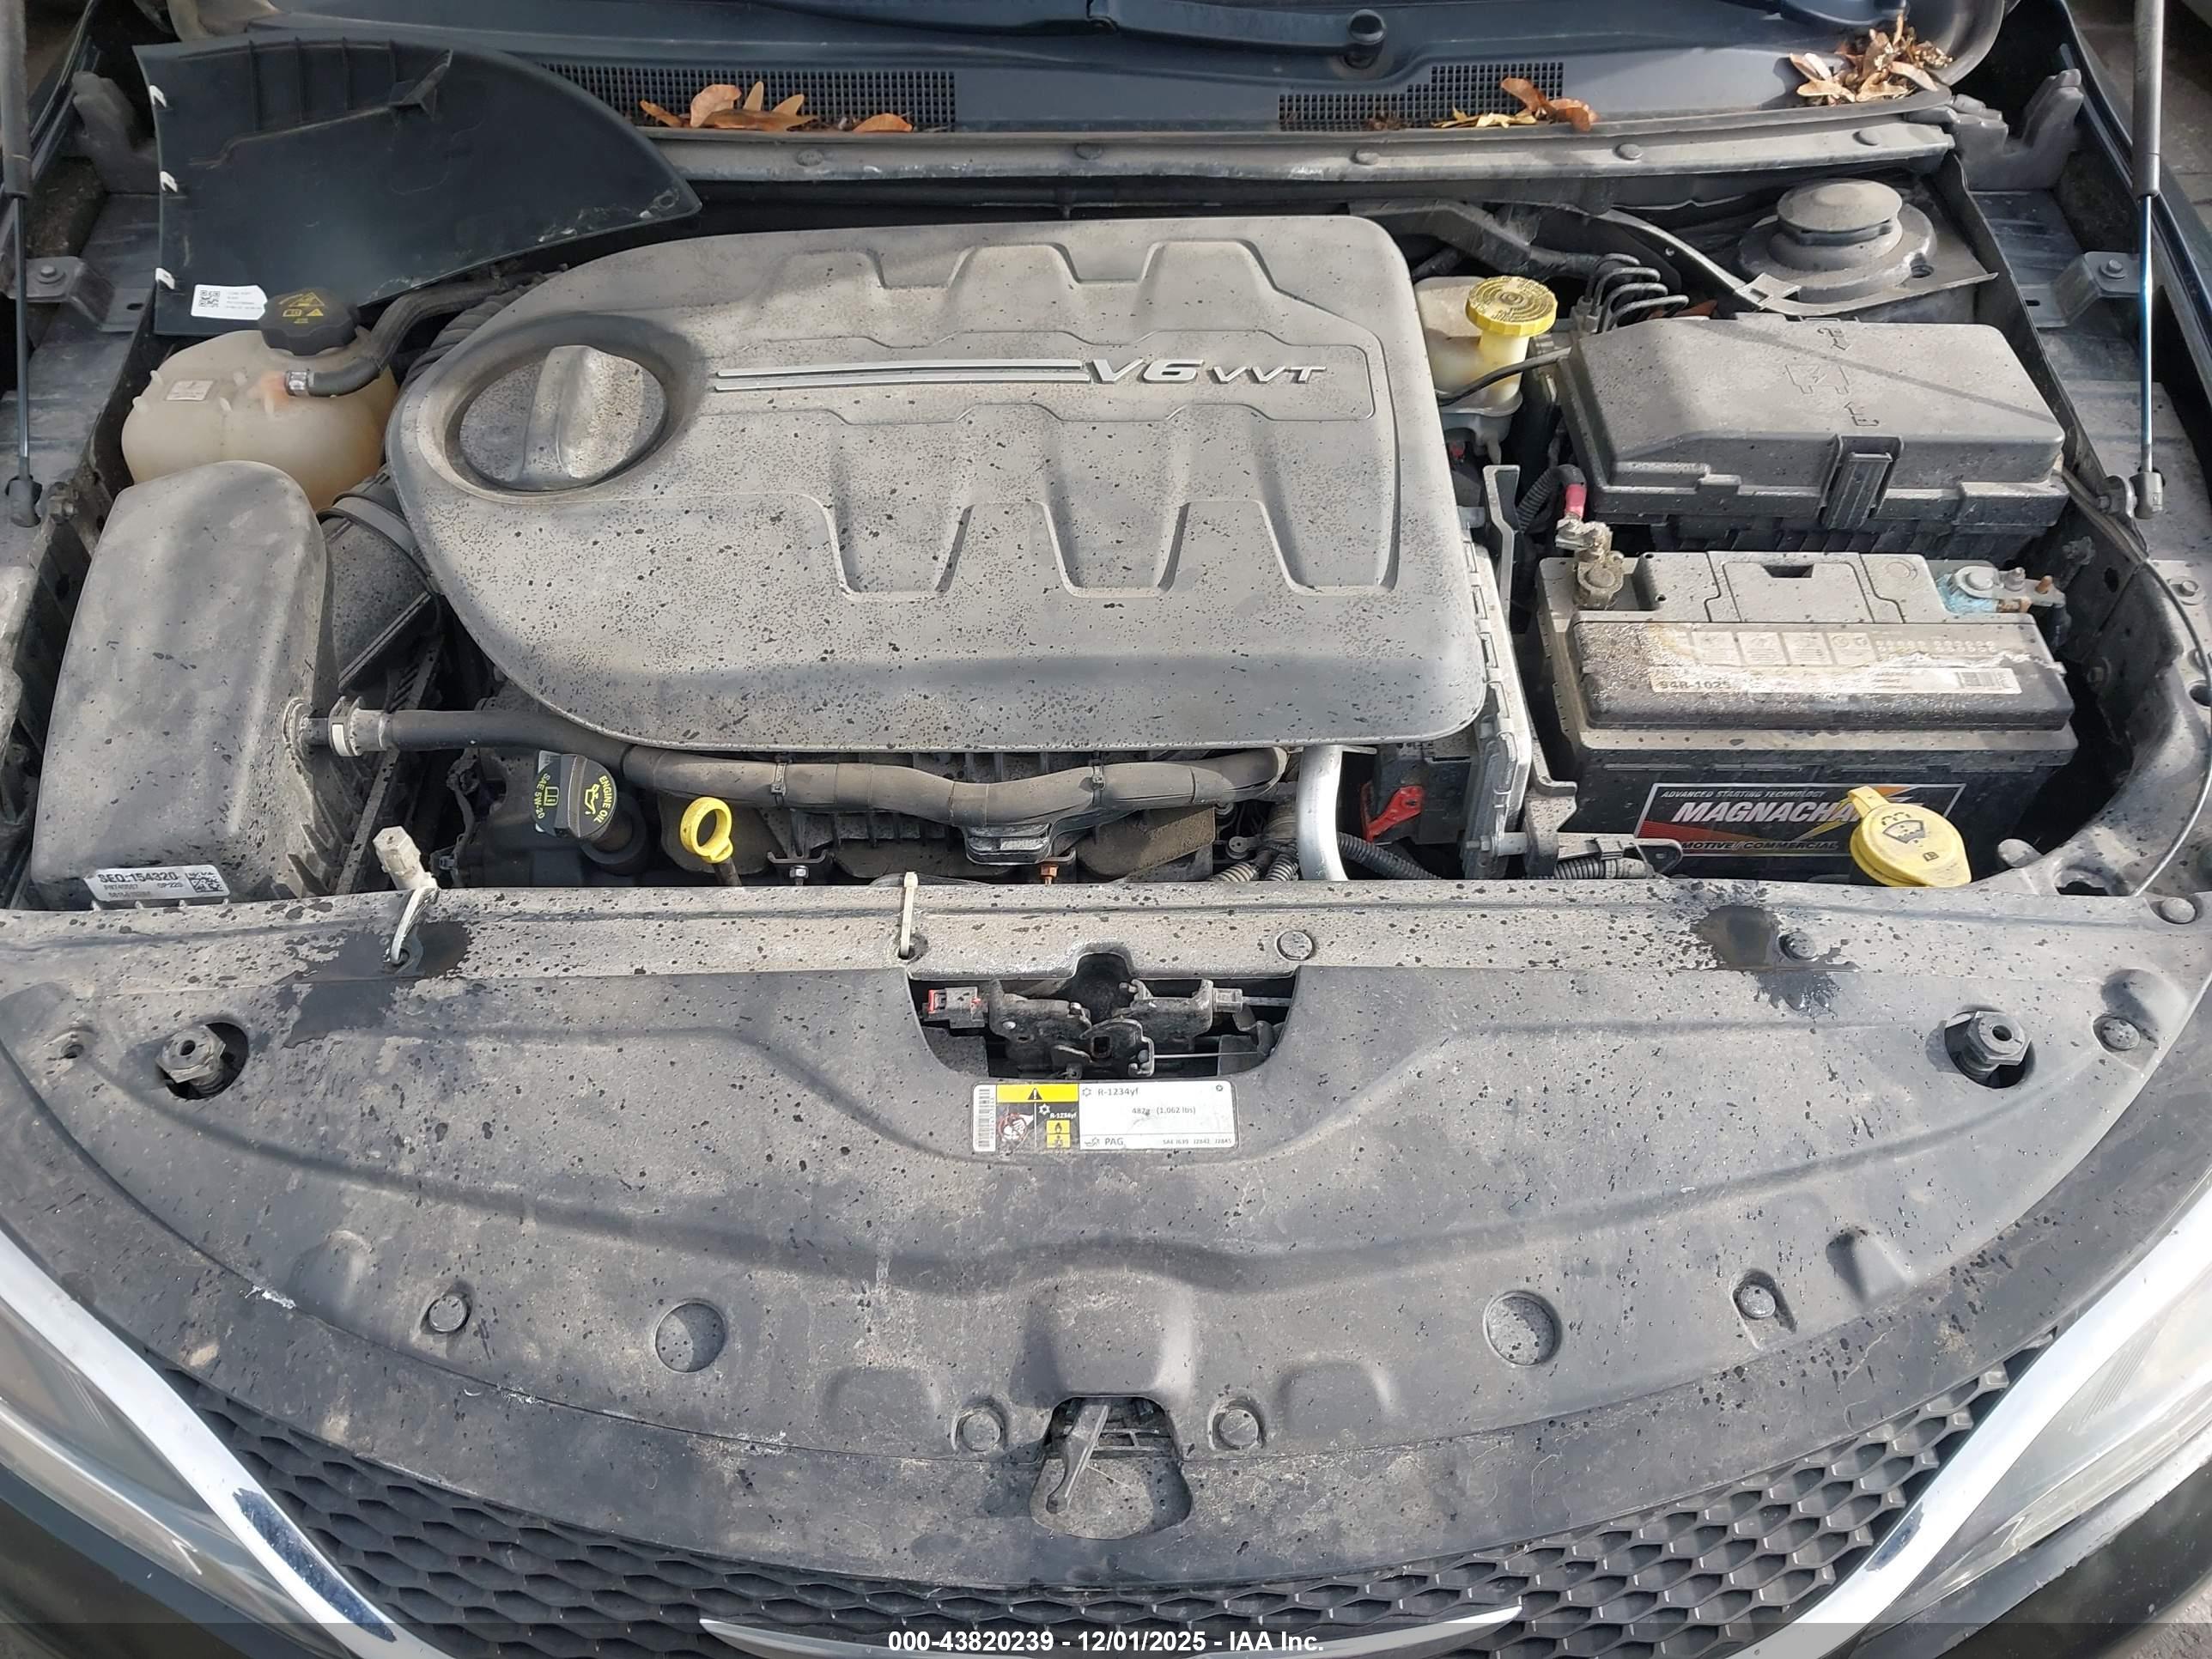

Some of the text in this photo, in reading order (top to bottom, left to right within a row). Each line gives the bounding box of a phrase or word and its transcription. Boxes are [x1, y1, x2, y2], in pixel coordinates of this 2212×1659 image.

[1091, 359, 1327, 384] V6 VVT
[533, 773, 551, 819] SAE 5W-20
[593, 775, 612, 823] ENGINE OIL
[1661, 790, 1826, 799] ADVANCED STARTING TECHNOLOGY
[1671, 801, 1862, 823] MAGNACHA
[1681, 841, 1840, 851] MOTIVE/COMMERCIAL
[1097, 1087, 1139, 1097] R-1234yf
[1156, 1106, 1181, 1115] (1.062
